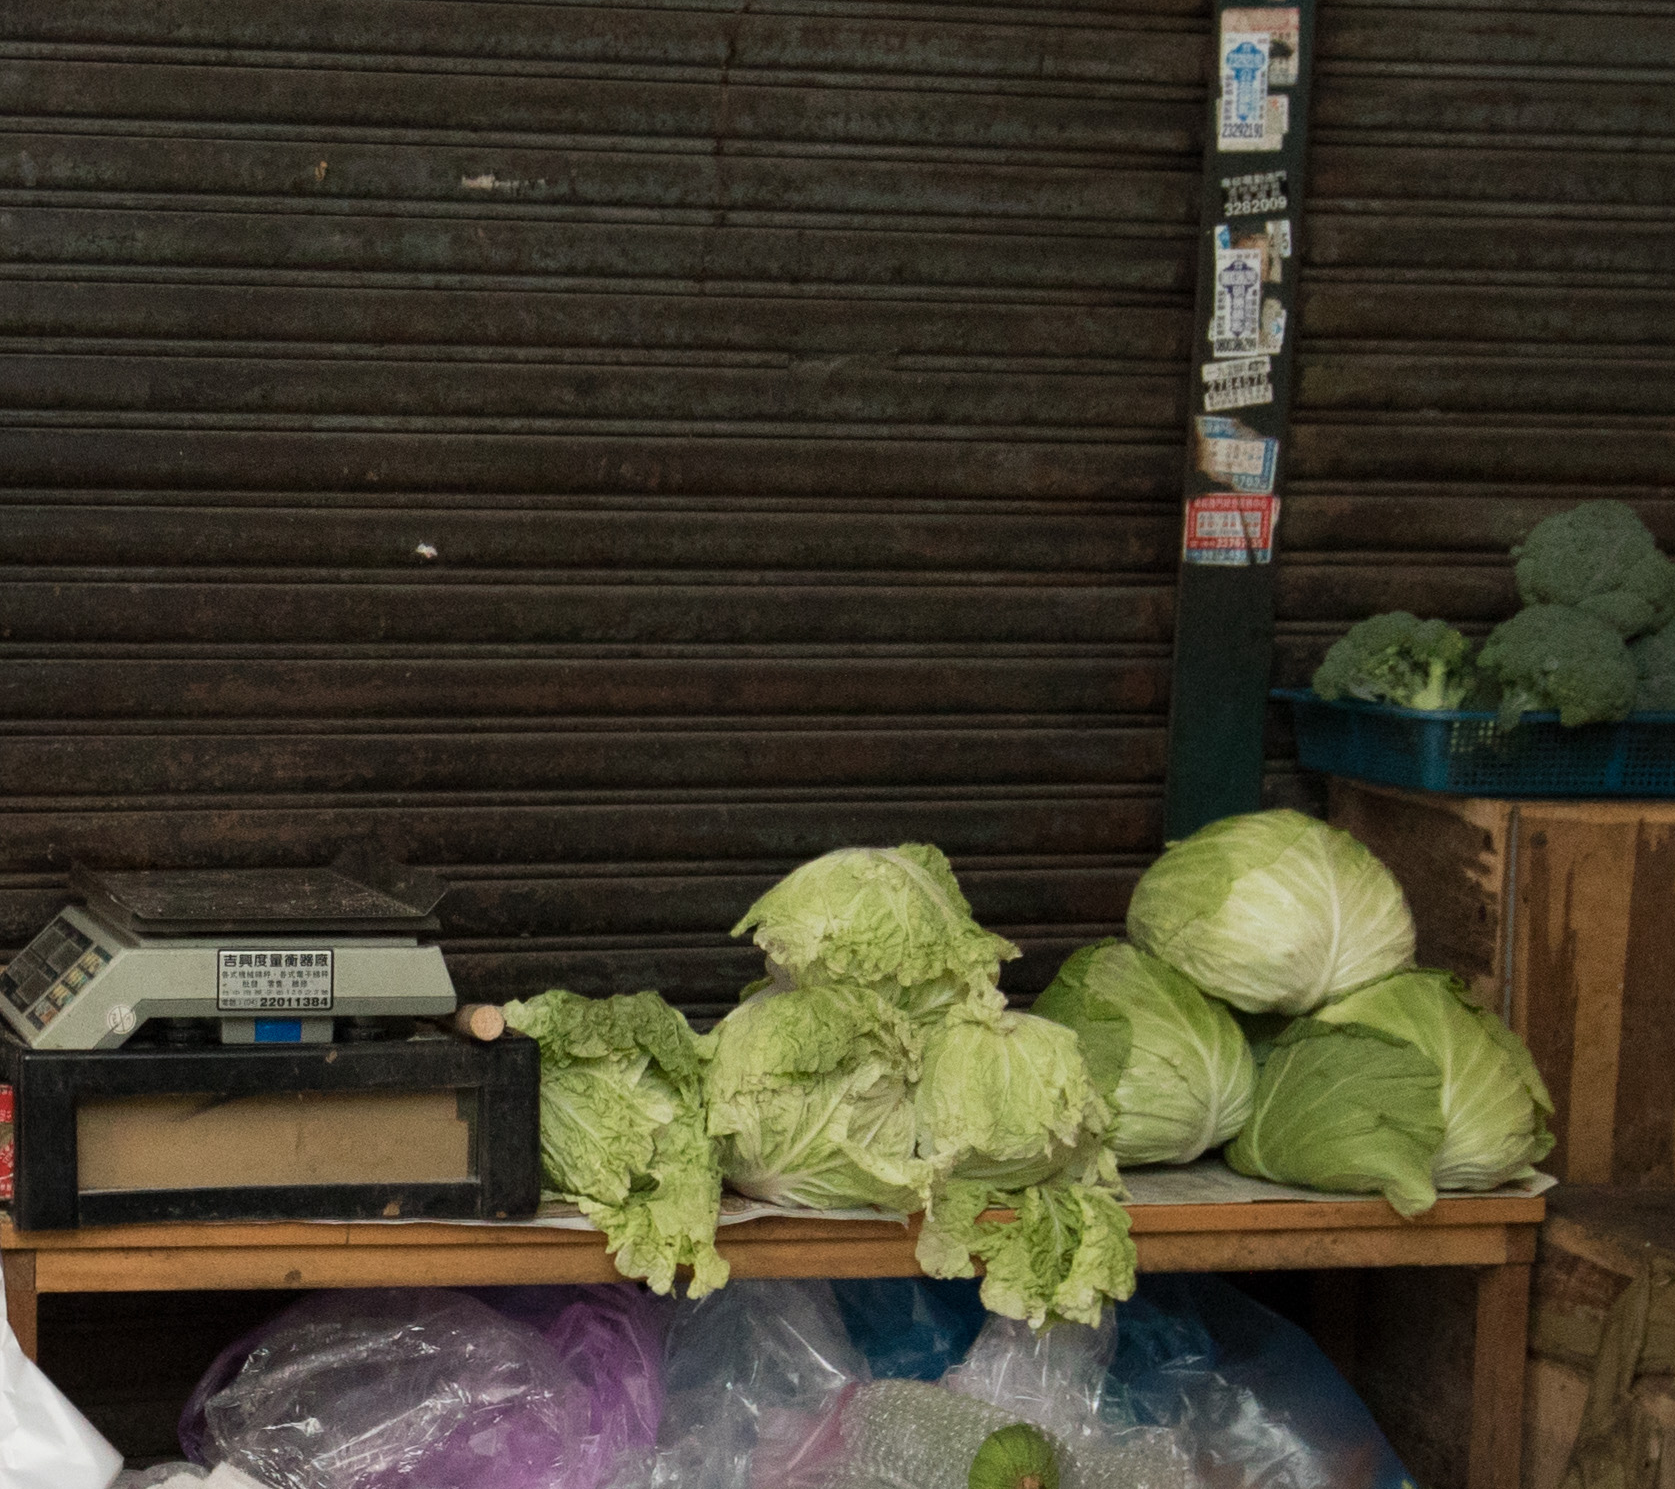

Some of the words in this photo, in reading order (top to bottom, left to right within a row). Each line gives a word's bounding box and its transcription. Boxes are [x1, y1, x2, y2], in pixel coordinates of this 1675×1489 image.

[223, 953, 329, 968] 吉興度量衡器廠
[260, 996, 329, 1008] 22011384
